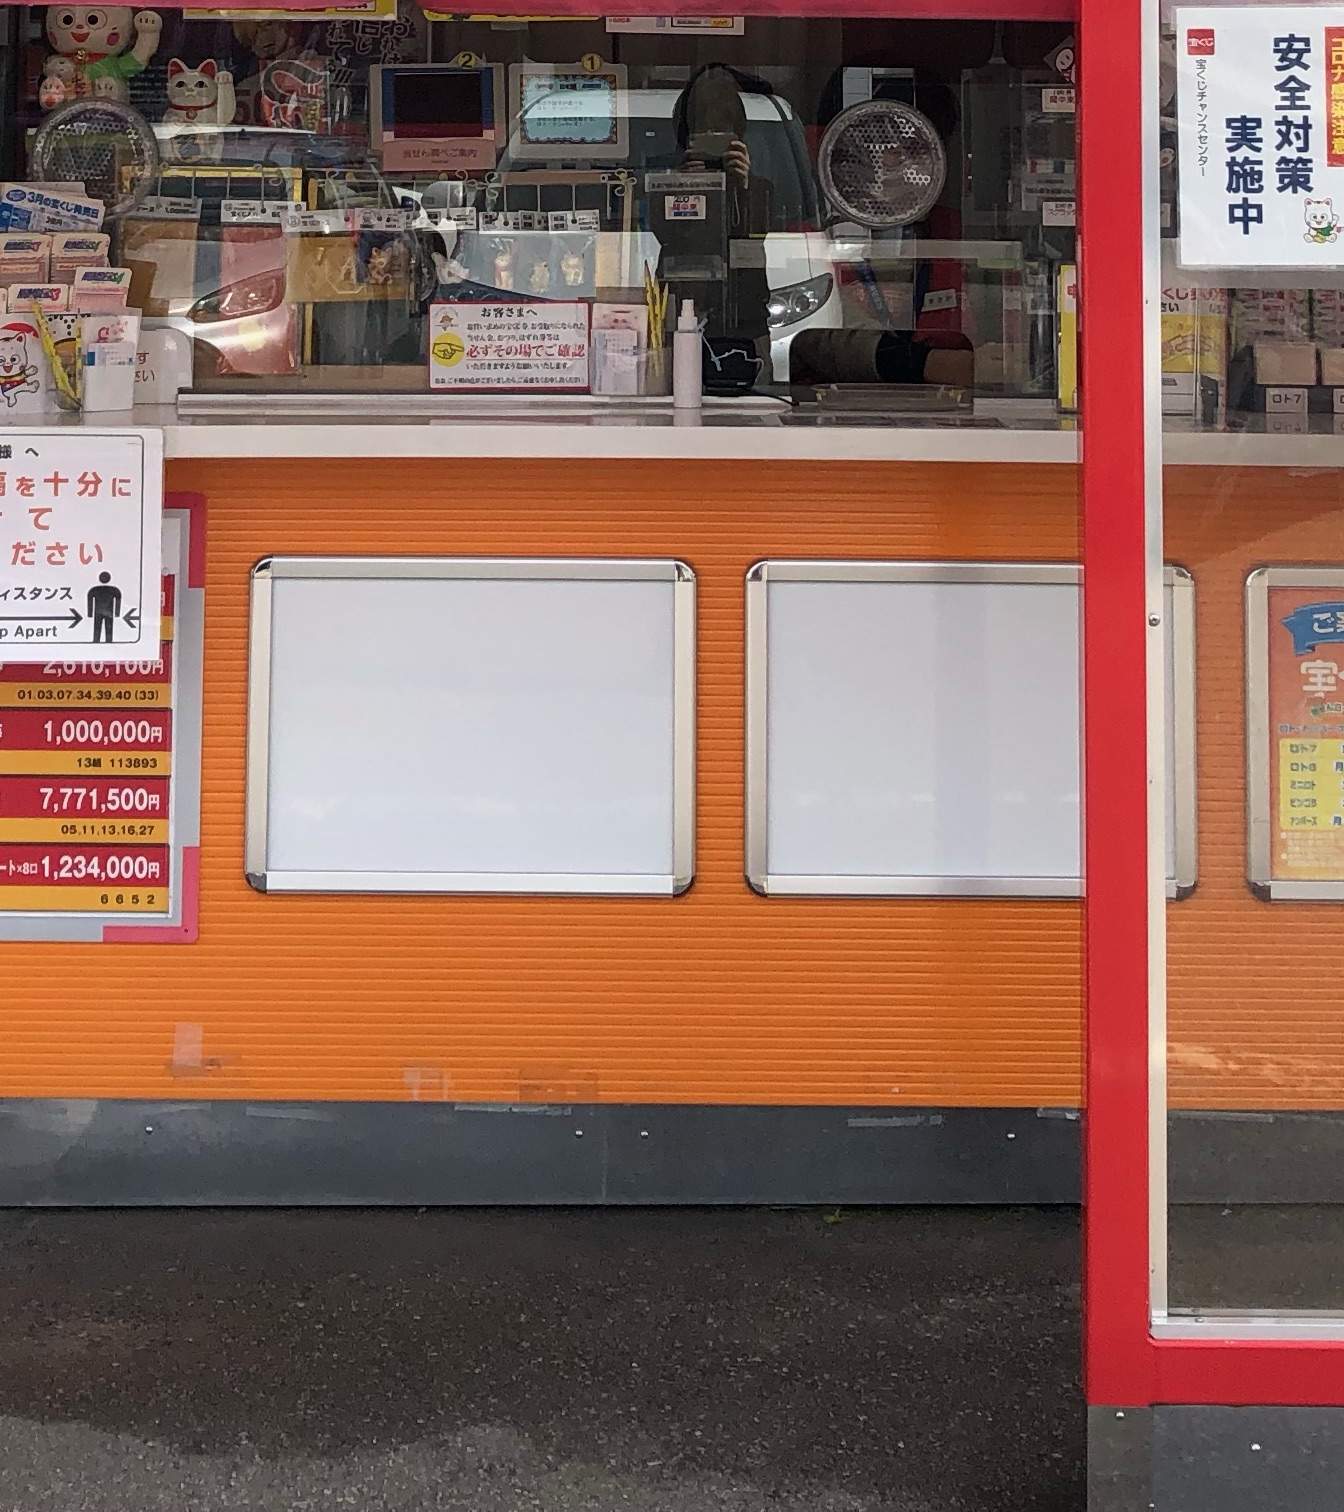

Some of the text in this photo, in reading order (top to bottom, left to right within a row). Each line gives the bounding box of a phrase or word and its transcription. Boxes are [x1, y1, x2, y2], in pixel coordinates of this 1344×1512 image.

[462, 52, 473, 68] 2
[1195, 59, 1209, 177] 宝くじチャンスセンター
[1272, 34, 1314, 195] 安全対策
[1225, 115, 1264, 235] 実施中
[466, 344, 585, 358] 必ずその場でご確認
[1272, 394, 1301, 404] ロト7
[14, 625, 58, 641] Apart
[44, 719, 163, 745] 1,000,000円
[40, 787, 160, 812] 7,771,500円
[41, 856, 160, 880] 1,234,000円
